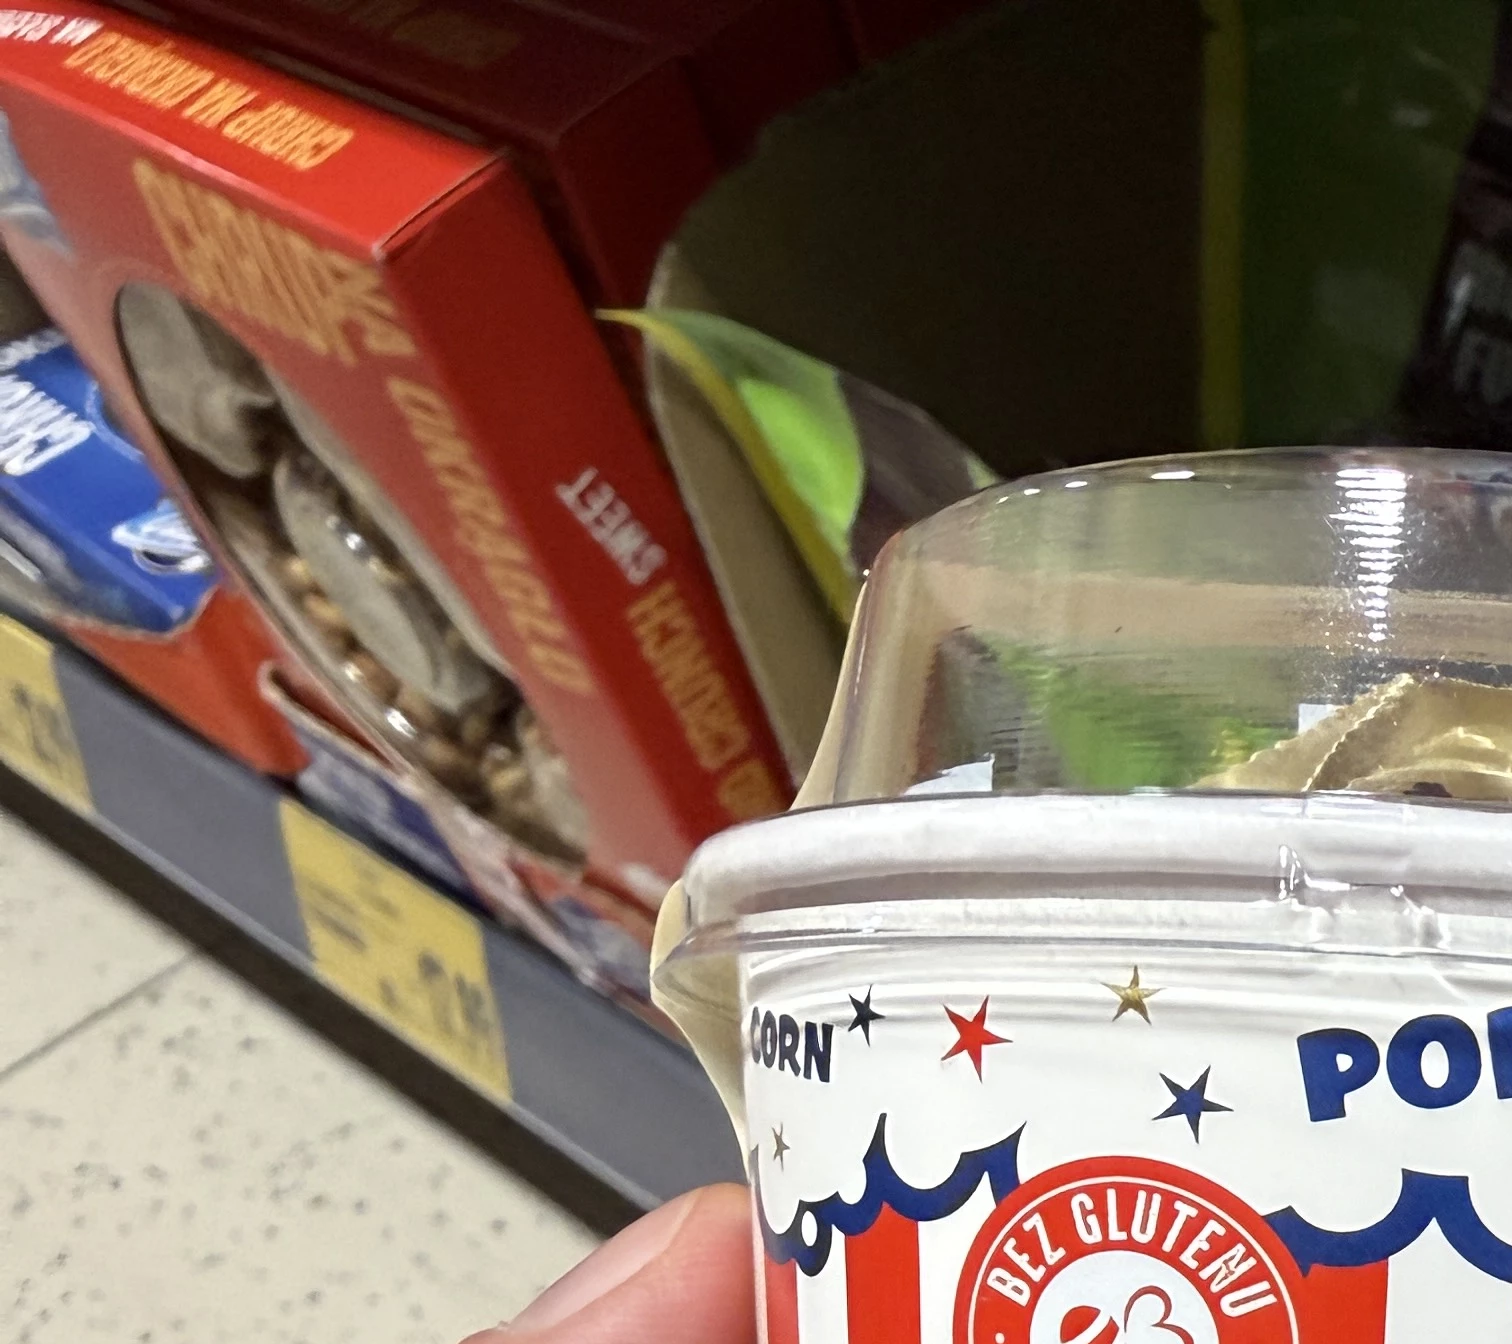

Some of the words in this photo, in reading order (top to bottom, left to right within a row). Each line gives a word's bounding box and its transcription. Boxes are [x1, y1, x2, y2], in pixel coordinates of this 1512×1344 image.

[181, 77, 260, 129] NA
[221, 100, 355, 172] CHRUP
[554, 465, 668, 586] SWEET
[750, 1005, 835, 1084] CORN
[986, 1212, 1066, 1308] BEZ
[1070, 1187, 1278, 1318] GLUTENU
